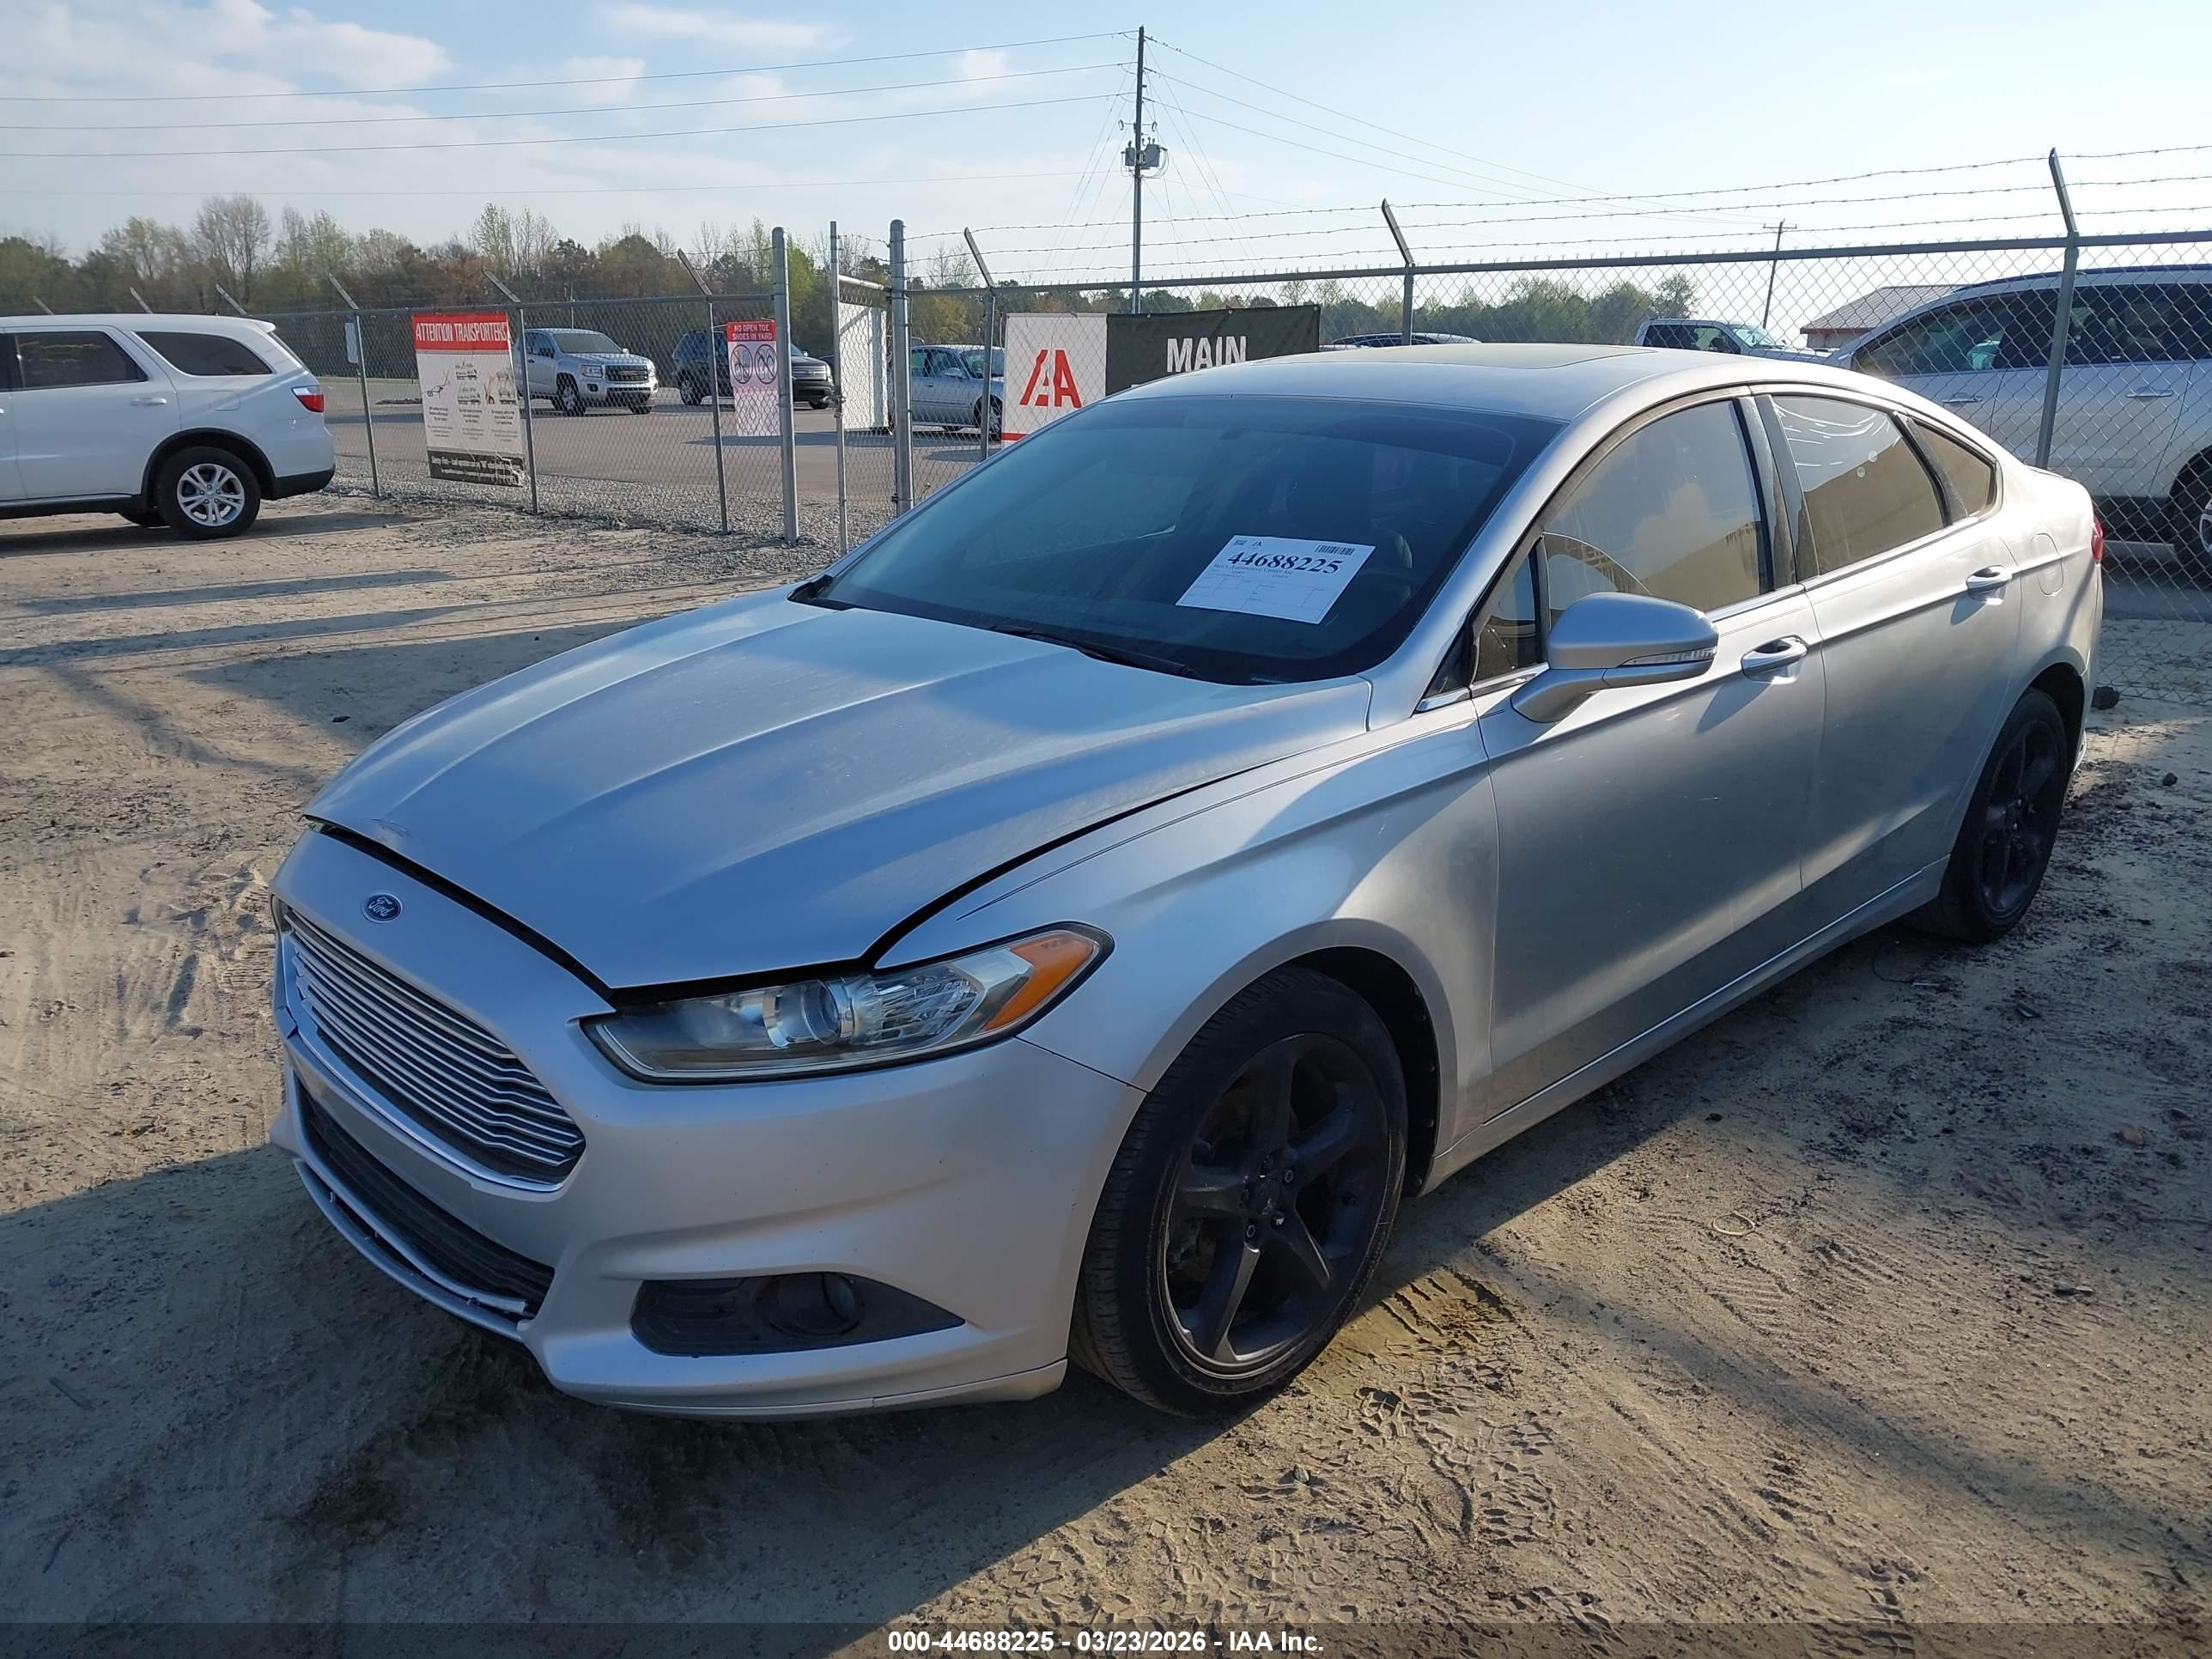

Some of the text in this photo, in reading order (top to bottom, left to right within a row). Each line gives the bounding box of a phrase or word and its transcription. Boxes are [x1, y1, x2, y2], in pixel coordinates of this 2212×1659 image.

[416, 323, 453, 342] ATTENTION
[1167, 336, 1246, 372] MAIN
[1228, 552, 1343, 574] 44688225
[368, 896, 395, 917] Ford
